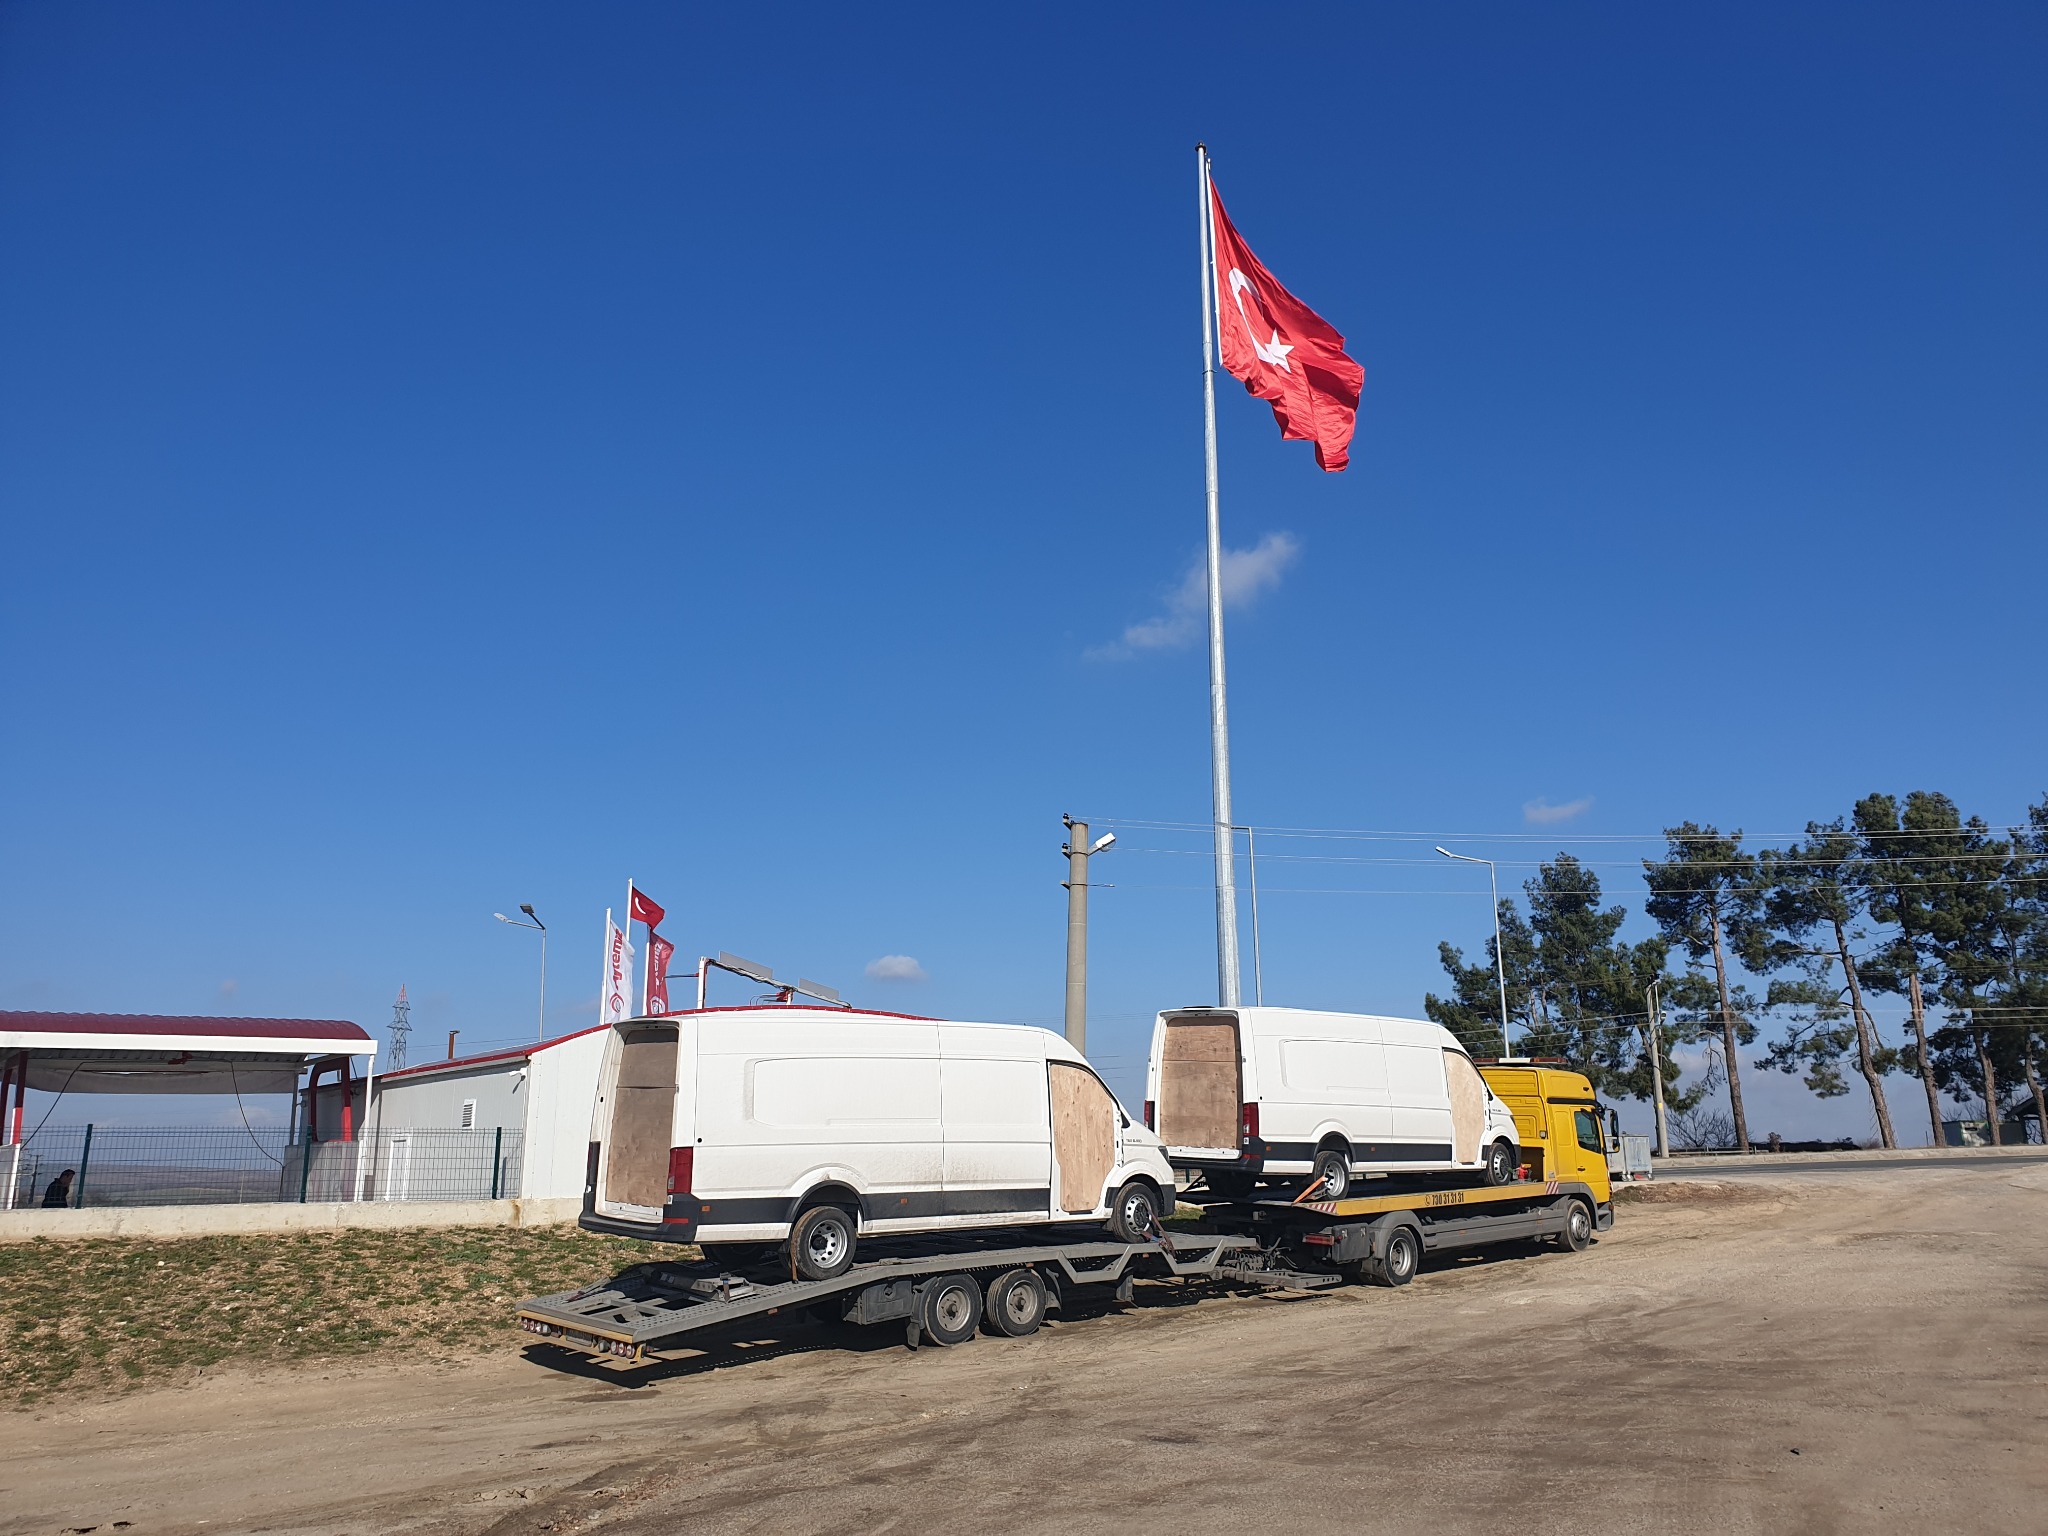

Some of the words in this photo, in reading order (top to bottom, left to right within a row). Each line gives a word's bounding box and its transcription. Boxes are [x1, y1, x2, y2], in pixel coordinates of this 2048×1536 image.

[1432, 1194, 1442, 1205] 730
[1443, 1193, 1450, 1204] 31
[1451, 1192, 1457, 1203] 31
[1458, 1192, 1464, 1202] 31
